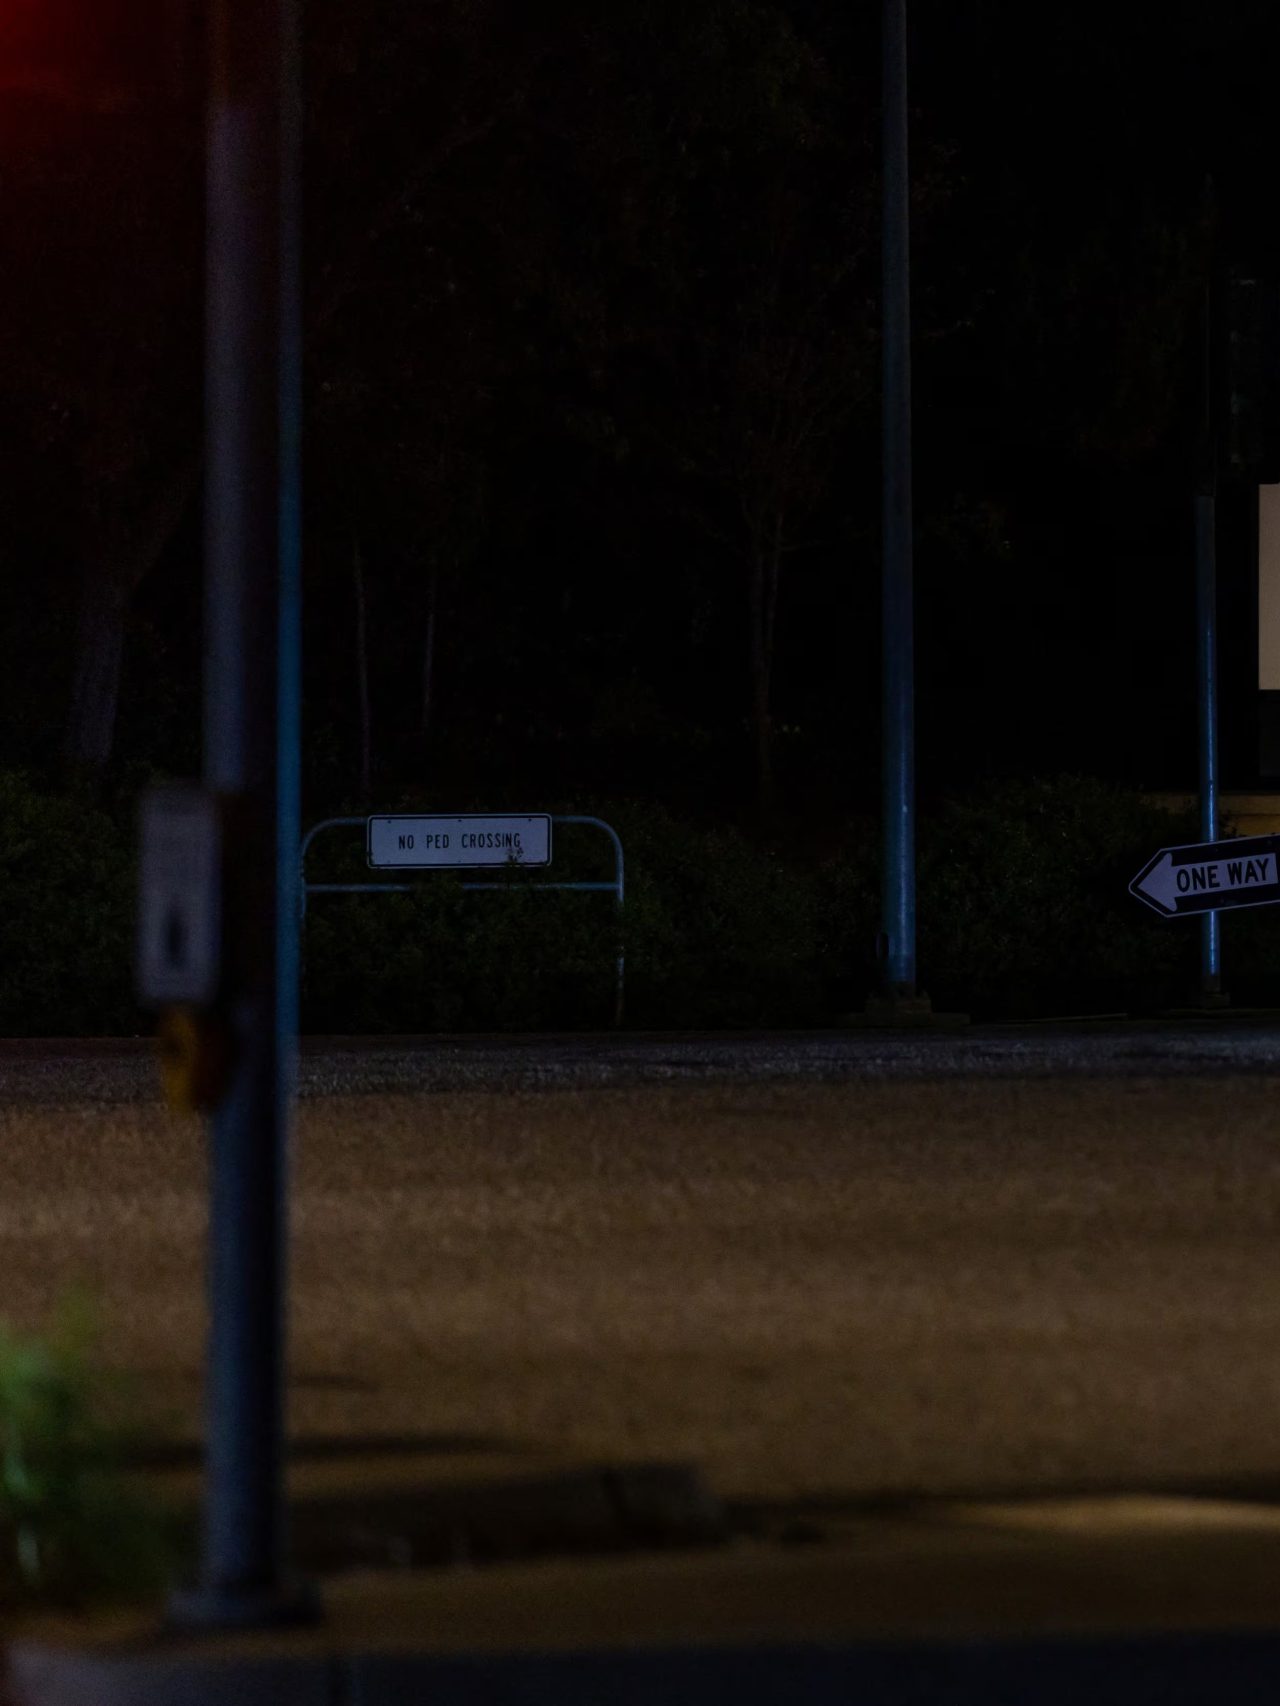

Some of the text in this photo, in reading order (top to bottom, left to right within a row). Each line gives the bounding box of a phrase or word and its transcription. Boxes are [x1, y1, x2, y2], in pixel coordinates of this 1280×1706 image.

[398, 832, 521, 849] NO PED CROSSING
[1176, 858, 1269, 893] ONE WAY
